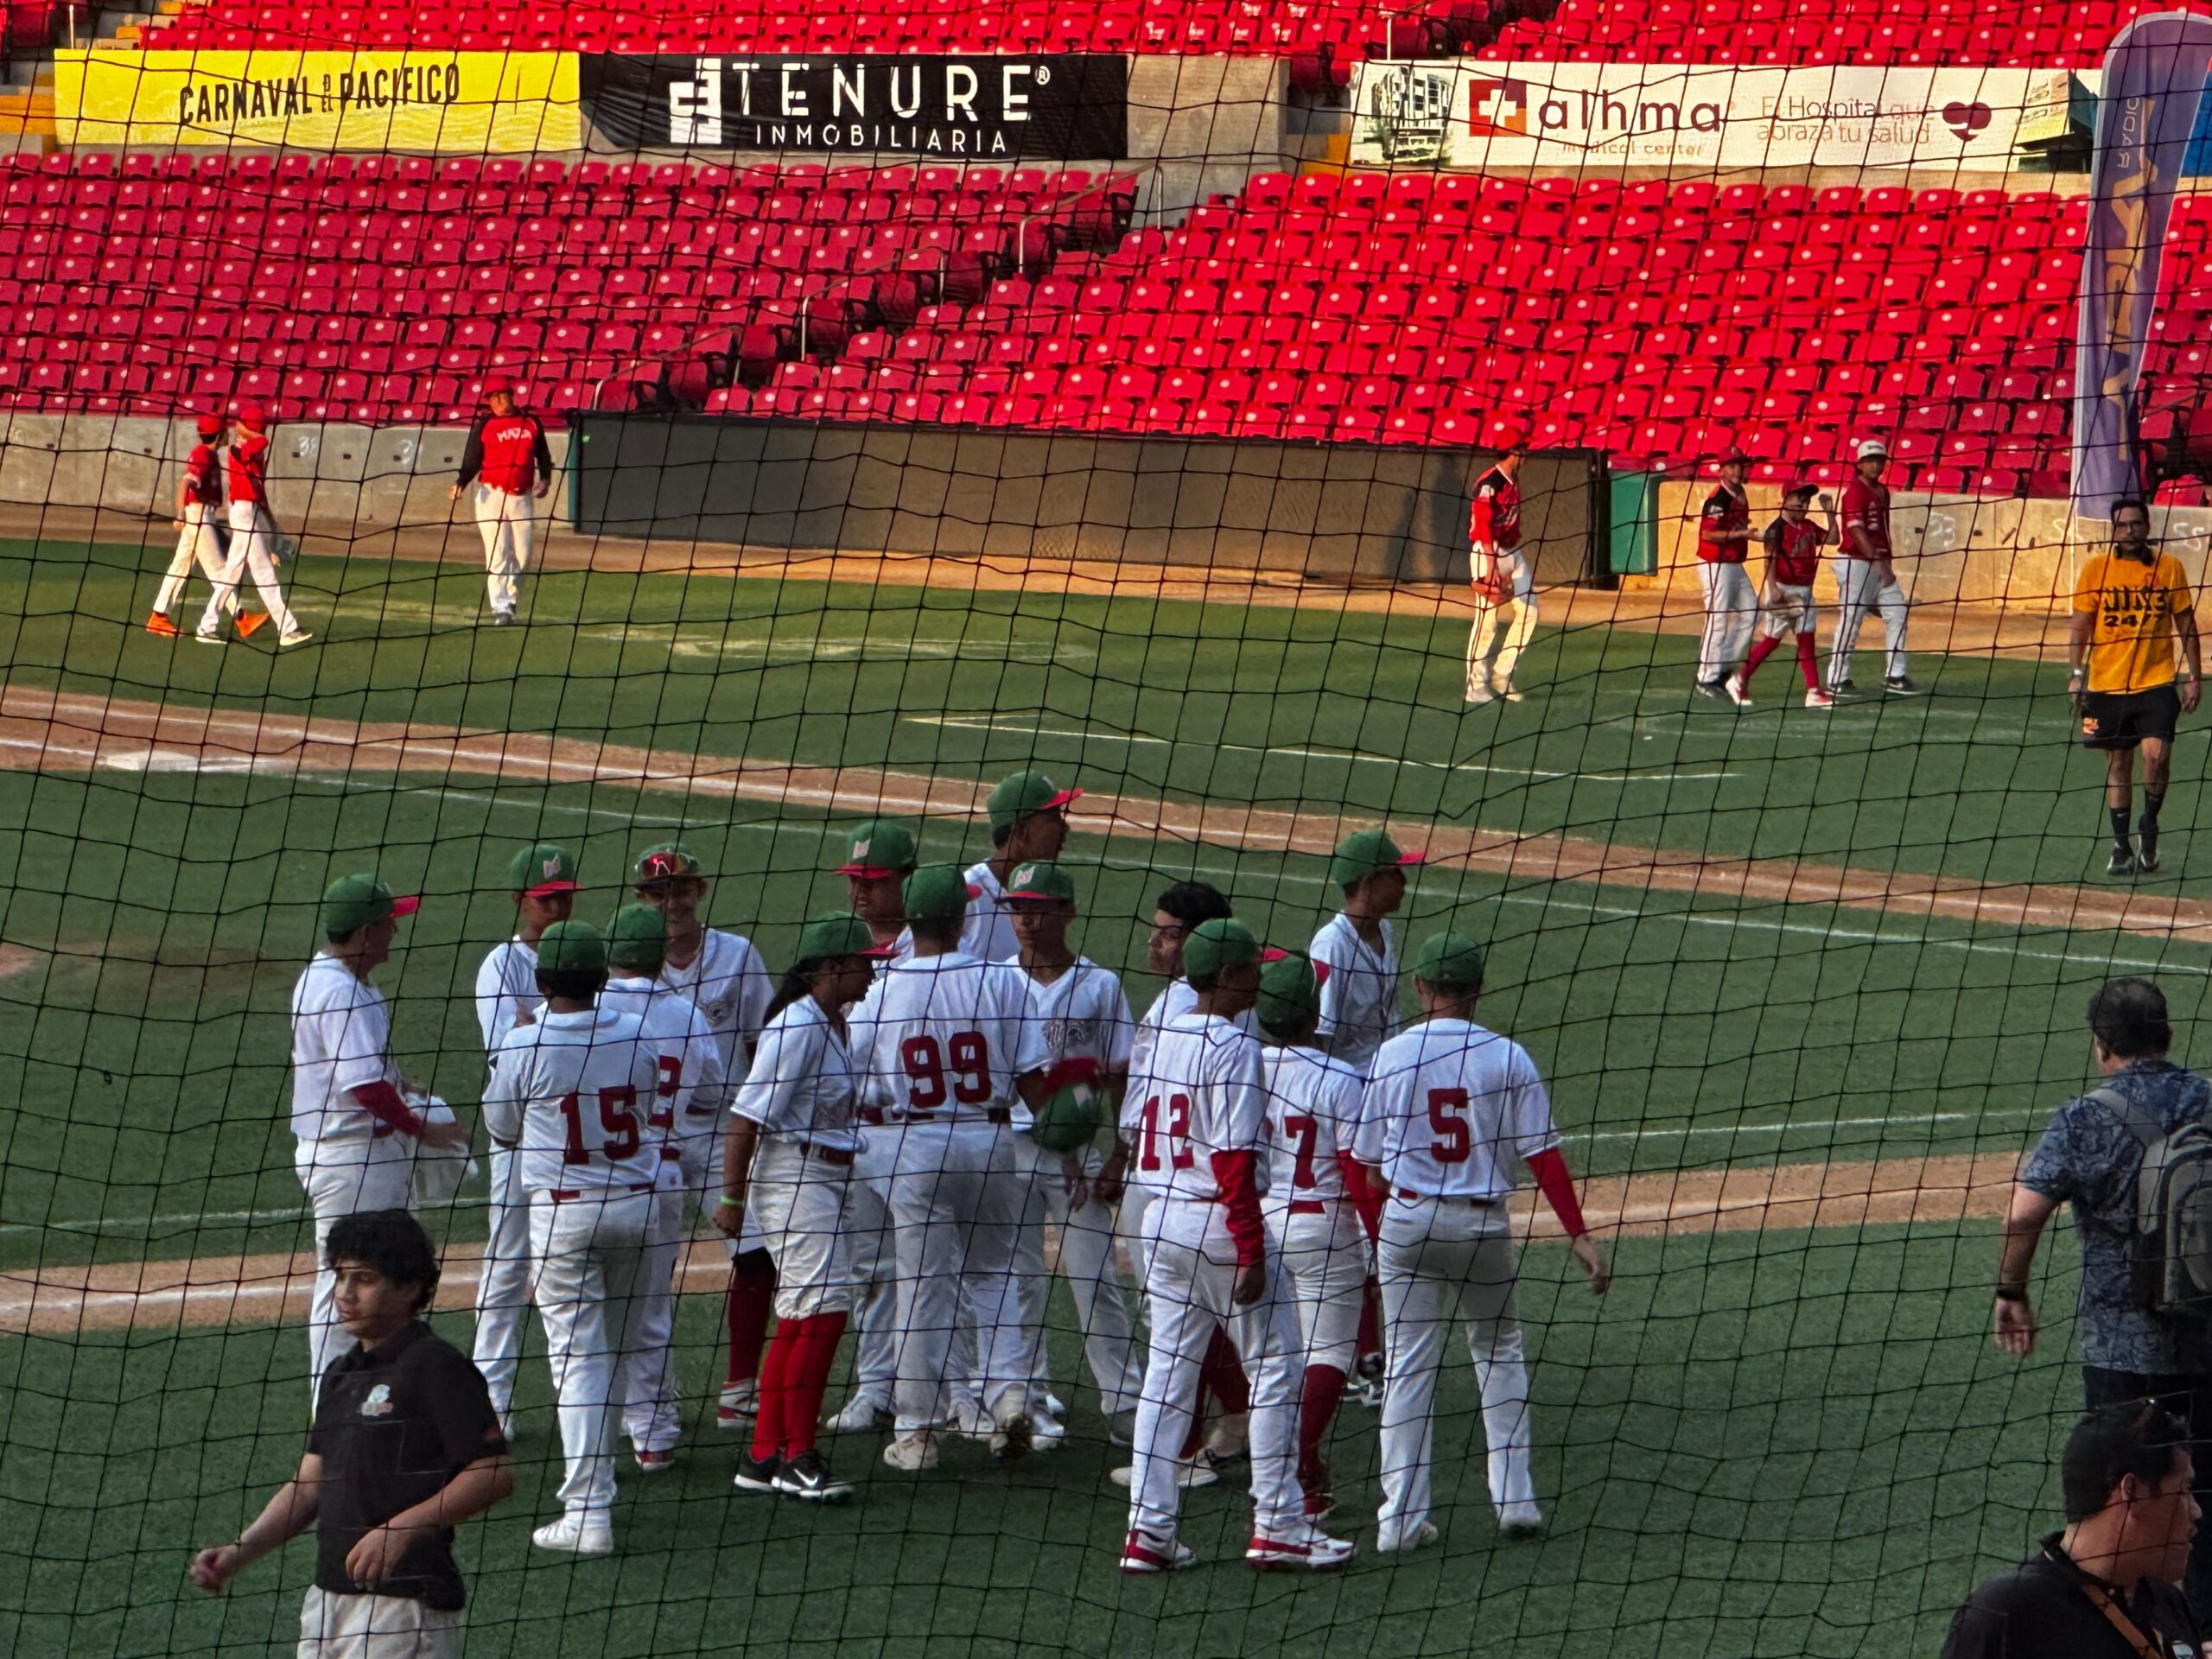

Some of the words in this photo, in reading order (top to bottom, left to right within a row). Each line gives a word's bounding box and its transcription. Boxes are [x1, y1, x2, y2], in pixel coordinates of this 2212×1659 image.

[180, 76, 312, 124] CARNAVAL
[340, 63, 460, 111] PACIFICO
[1538, 89, 1720, 132] alhma
[1762, 95, 1780, 118] E
[755, 124, 1007, 154] INMOBILIARIA
[901, 1031, 992, 1109] 99
[559, 1084, 639, 1166] 15
[1141, 1093, 1194, 1172] 12
[1264, 1116, 1319, 1189] 7
[1427, 1088, 1470, 1163] 5
